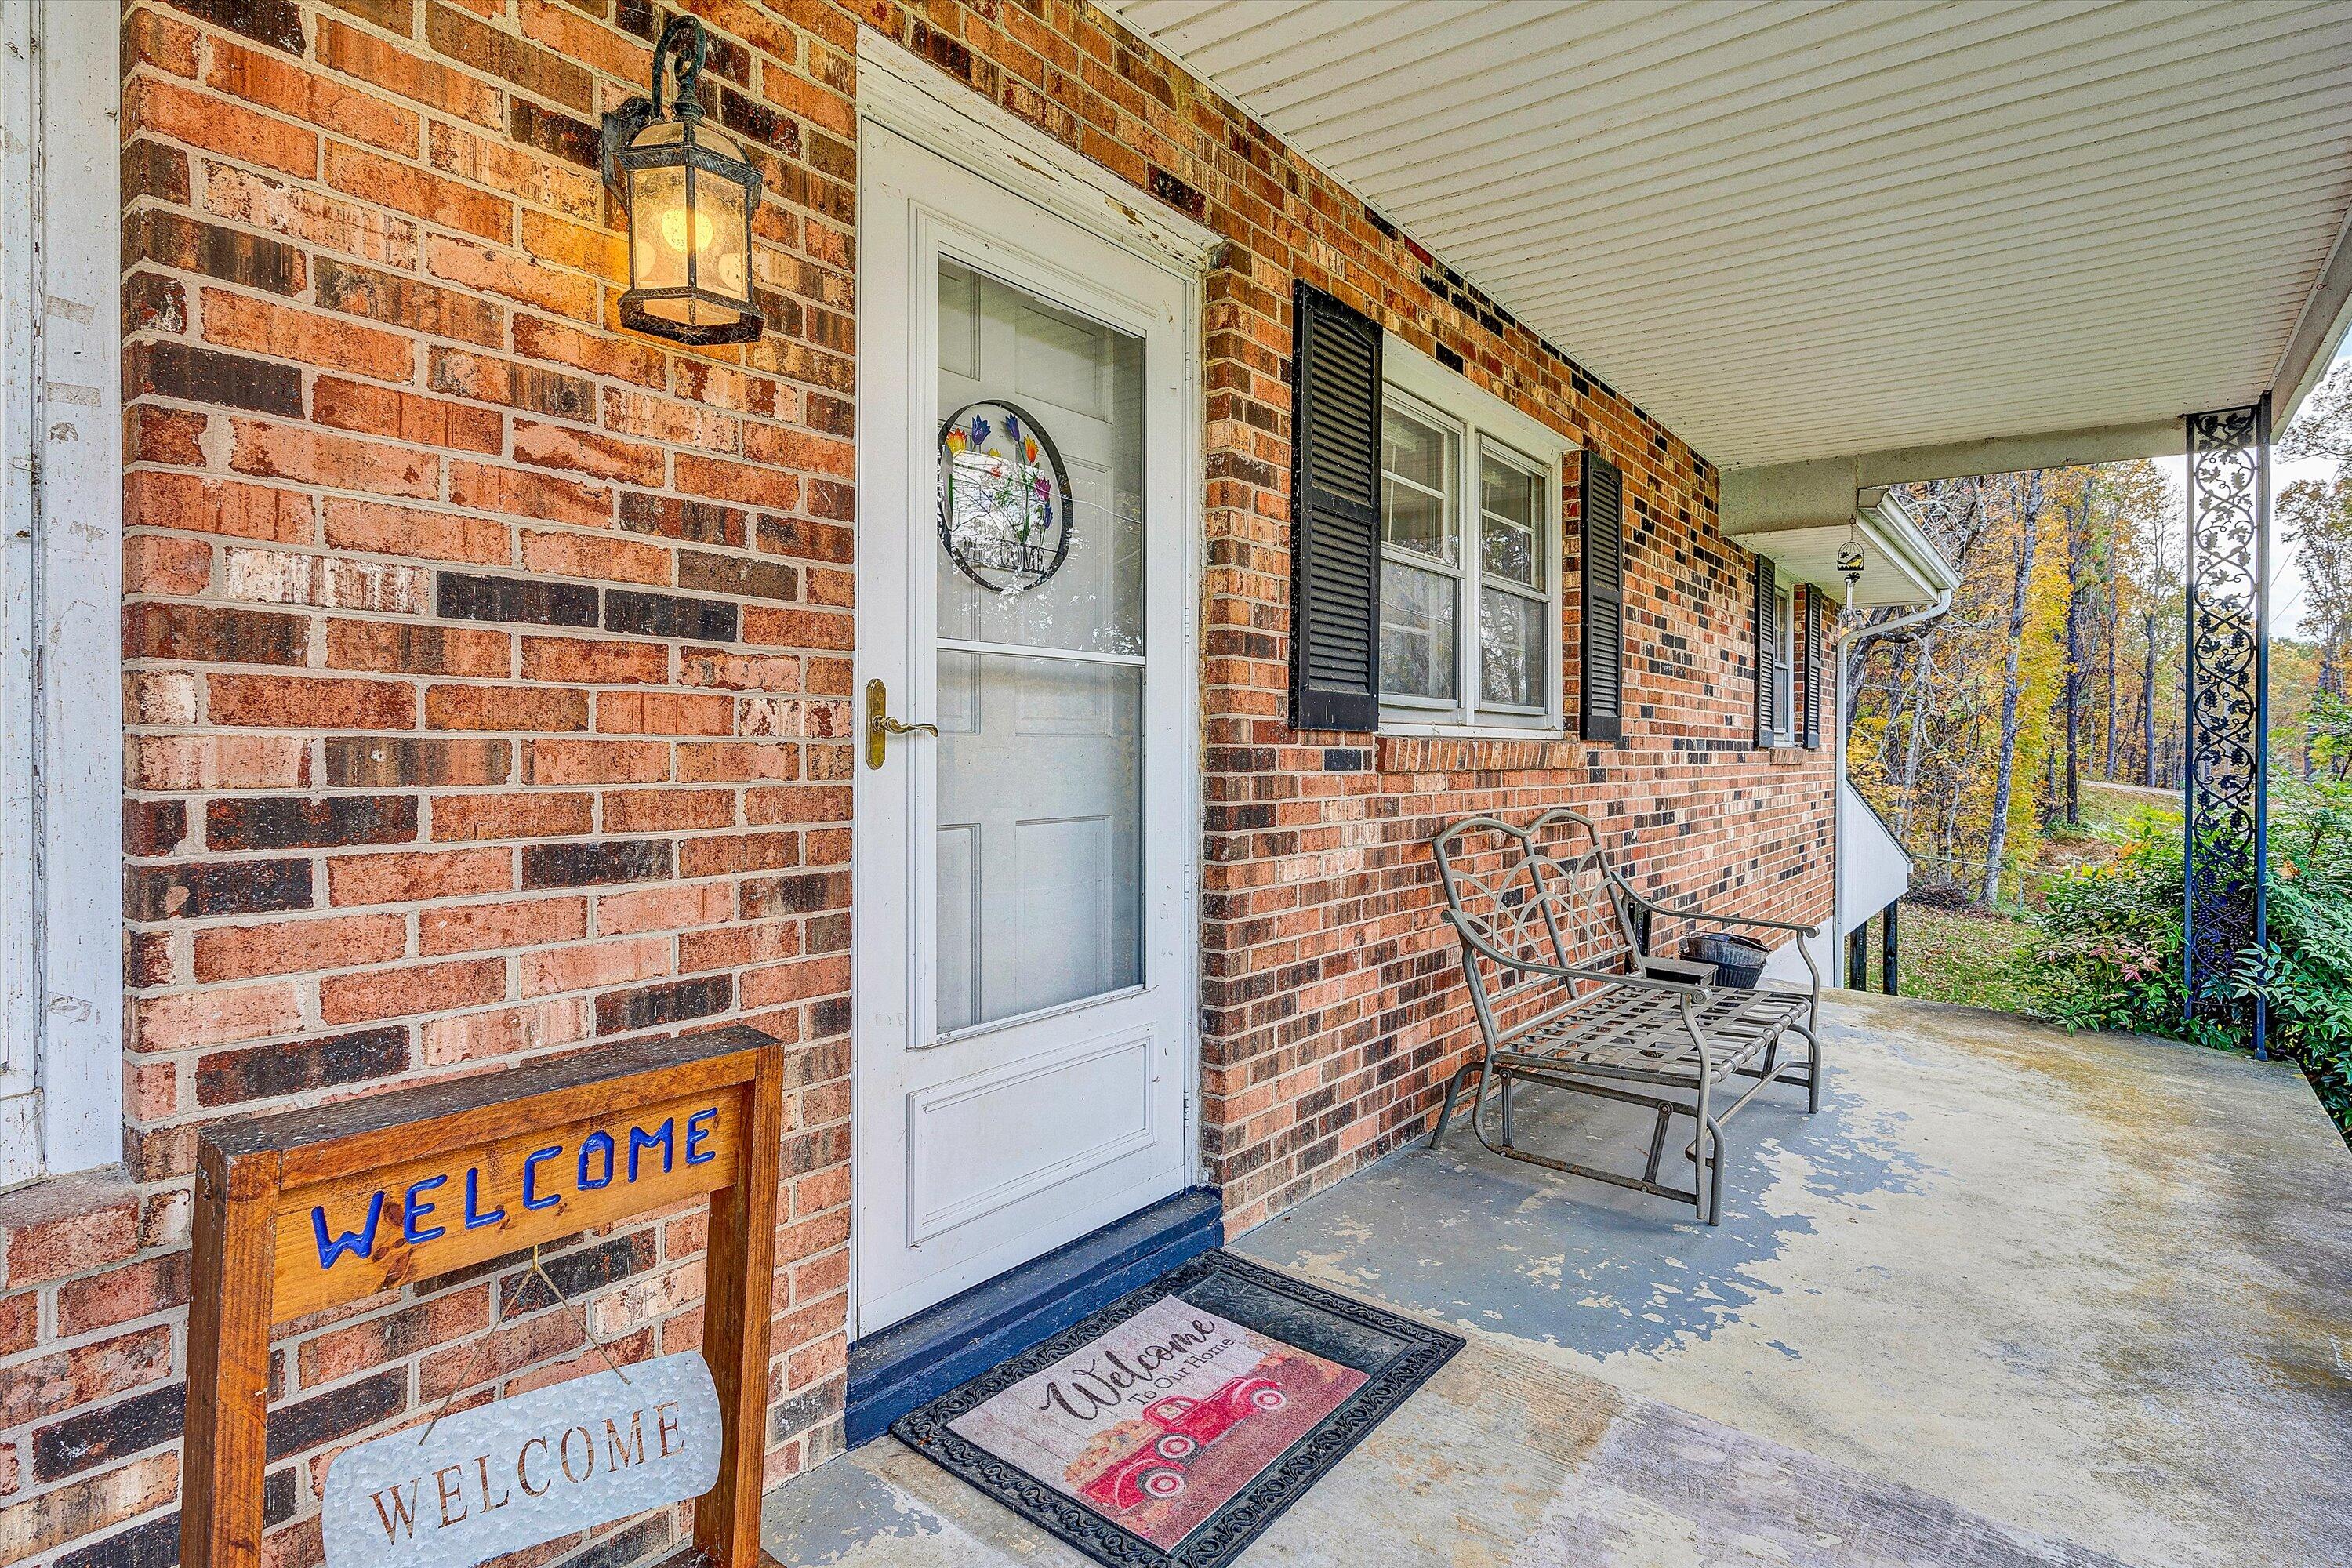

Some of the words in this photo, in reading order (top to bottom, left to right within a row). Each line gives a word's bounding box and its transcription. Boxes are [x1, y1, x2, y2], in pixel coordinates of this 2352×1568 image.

[311, 1107, 718, 1269] WELCOME
[1039, 1320, 1215, 1420] Welcome
[1127, 1390, 1156, 1405] To
[1154, 1367, 1190, 1388] Our
[1184, 1338, 1235, 1367] Home
[369, 1400, 685, 1546] WELCOME
